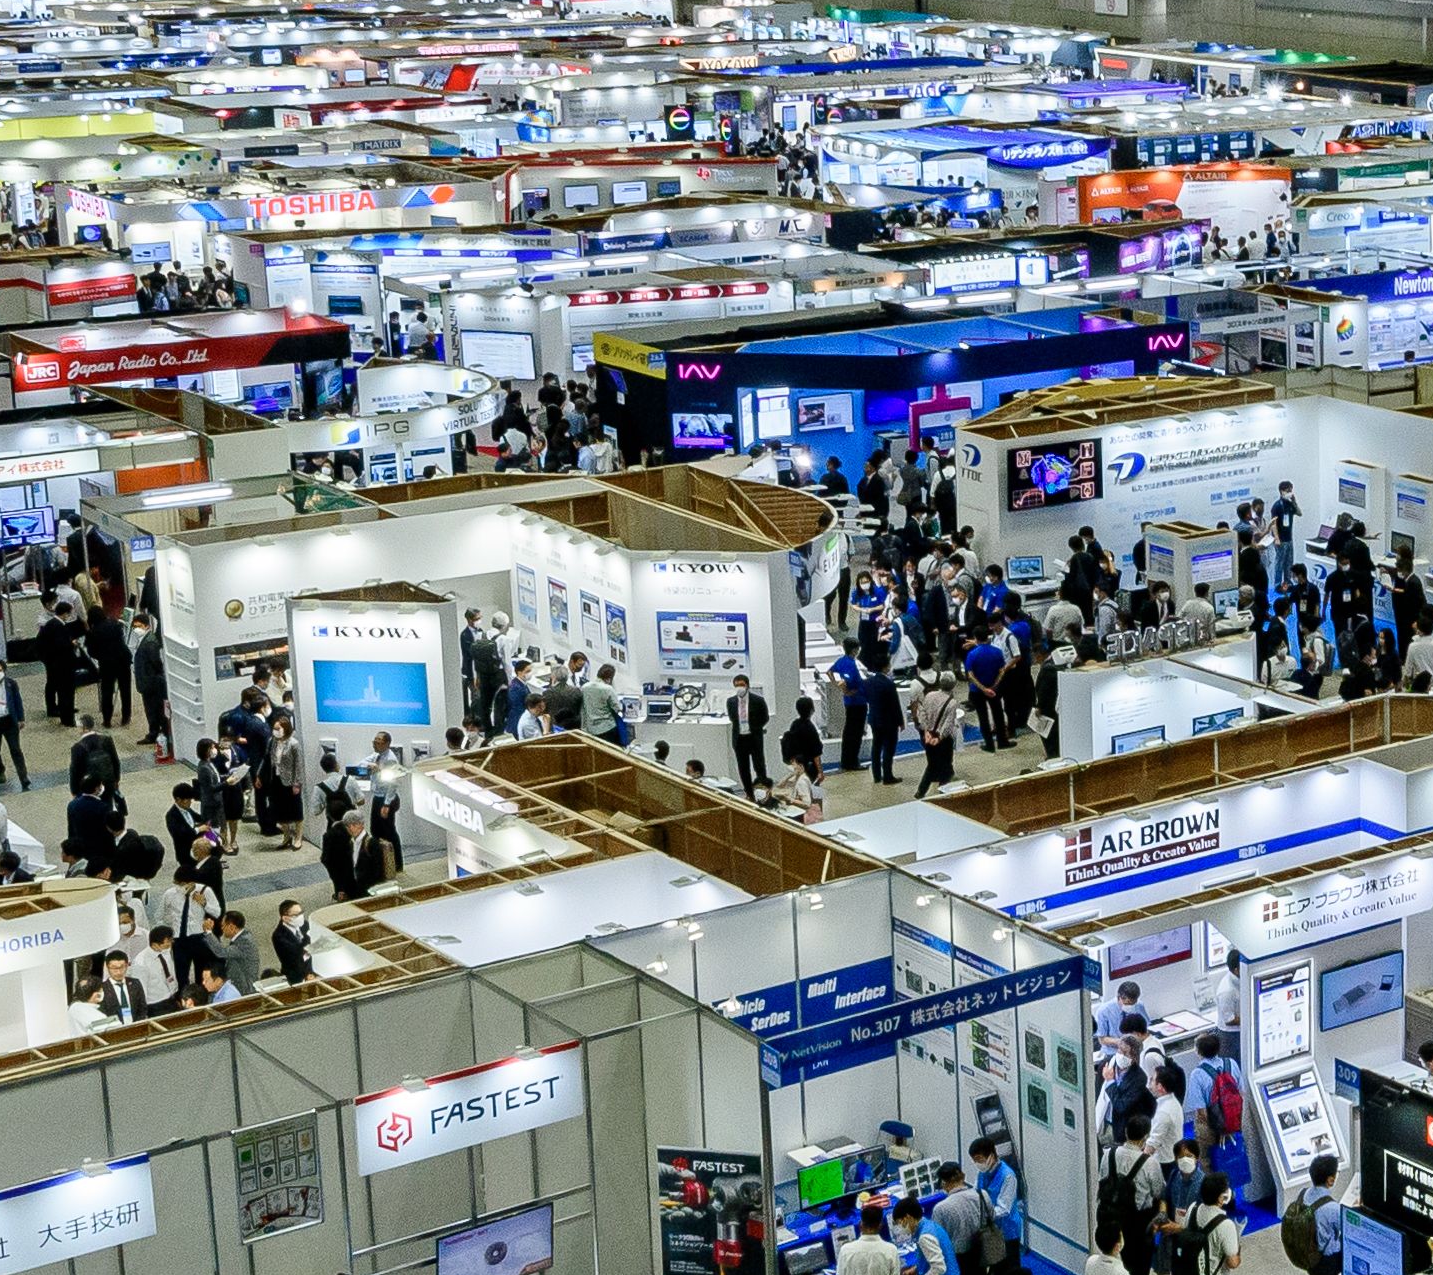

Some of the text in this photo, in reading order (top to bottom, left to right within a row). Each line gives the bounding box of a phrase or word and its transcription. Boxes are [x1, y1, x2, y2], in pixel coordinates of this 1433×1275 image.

[701, 58, 758, 70] YAZAKI
[363, 140, 400, 150] MATRIX
[1195, 171, 1227, 181] ALTAIR
[249, 190, 376, 219] TOSHIBA
[28, 364, 57, 379] JRC
[68, 348, 210, 380] Japan Radio Co., Ltd.
[679, 363, 722, 380] IAV
[365, 418, 410, 436] IPG
[133, 537, 152, 553] 280
[672, 562, 745, 576] KYOWA
[248, 592, 295, 607] 共和電業は
[334, 624, 422, 641] KYOWA
[418, 786, 485, 837] HORIBA
[1099, 808, 1219, 857] AR BROWN
[1238, 843, 1268, 857] 電動化
[1067, 866, 1101, 884] Think
[1102, 857, 1141, 878] Quality
[1152, 844, 1185, 863] Create
[1186, 835, 1218, 852] Value
[1283, 869, 1418, 918] エア・ブラウン株式会社
[1014, 898, 1047, 916] 電動化
[1266, 921, 1298, 941] Think
[1300, 912, 1339, 935] Quality
[1352, 901, 1386, 919] Create
[1387, 890, 1418, 910] Value
[806, 977, 837, 1000] Multi
[834, 984, 886, 1010] Interface
[750, 1009, 791, 1032] SerDes
[790, 968, 1072, 1059] NetVision No.307 株式会社ネットビジョン
[1336, 1065, 1358, 1080] 309
[430, 1076, 561, 1135] FASTEST
[692, 1159, 746, 1174] FASTEST
[37, 1202, 148, 1247] 大手技研
